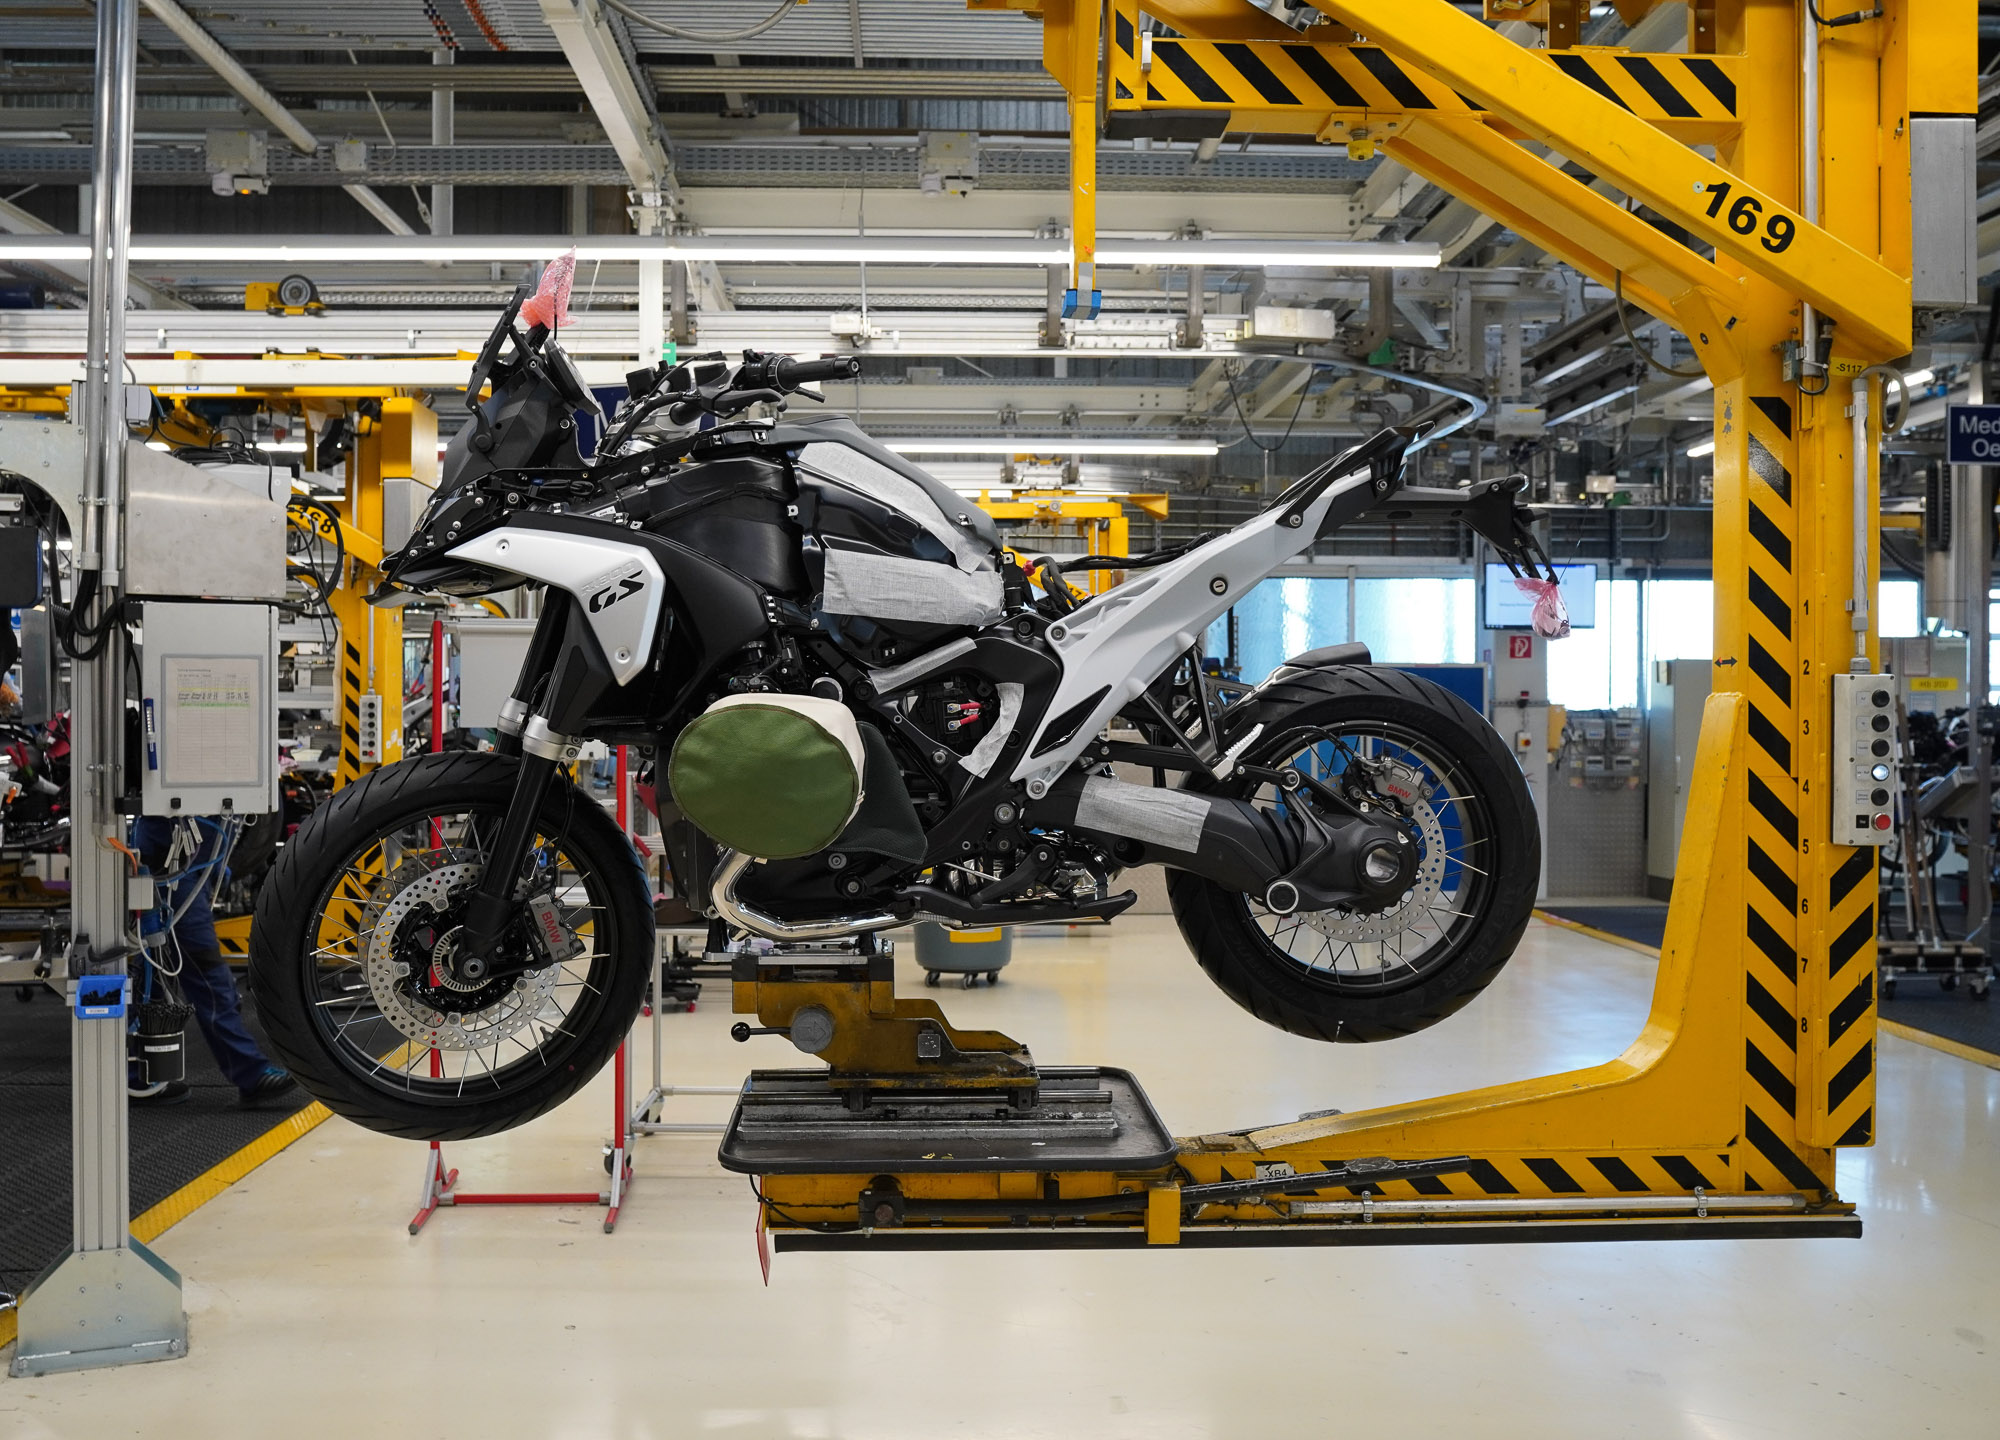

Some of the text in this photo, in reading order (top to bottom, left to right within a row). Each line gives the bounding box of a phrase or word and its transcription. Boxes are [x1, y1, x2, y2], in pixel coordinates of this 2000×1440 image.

[1705, 181, 1796, 254] 169
[1836, 362, 1862, 374] -S117
[588, 569, 645, 613] GS
[1803, 600, 1809, 615] 1
[1803, 660, 1810, 675] 2
[1803, 719, 1809, 735] 3
[1387, 784, 1411, 798] BMW
[1802, 779, 1809, 794] 4
[1802, 839, 1809, 854] 5
[1801, 898, 1808, 914] 6
[541, 911, 563, 943] BMW
[1801, 958, 1808, 973] 7
[1801, 1017, 1808, 1033] 8
